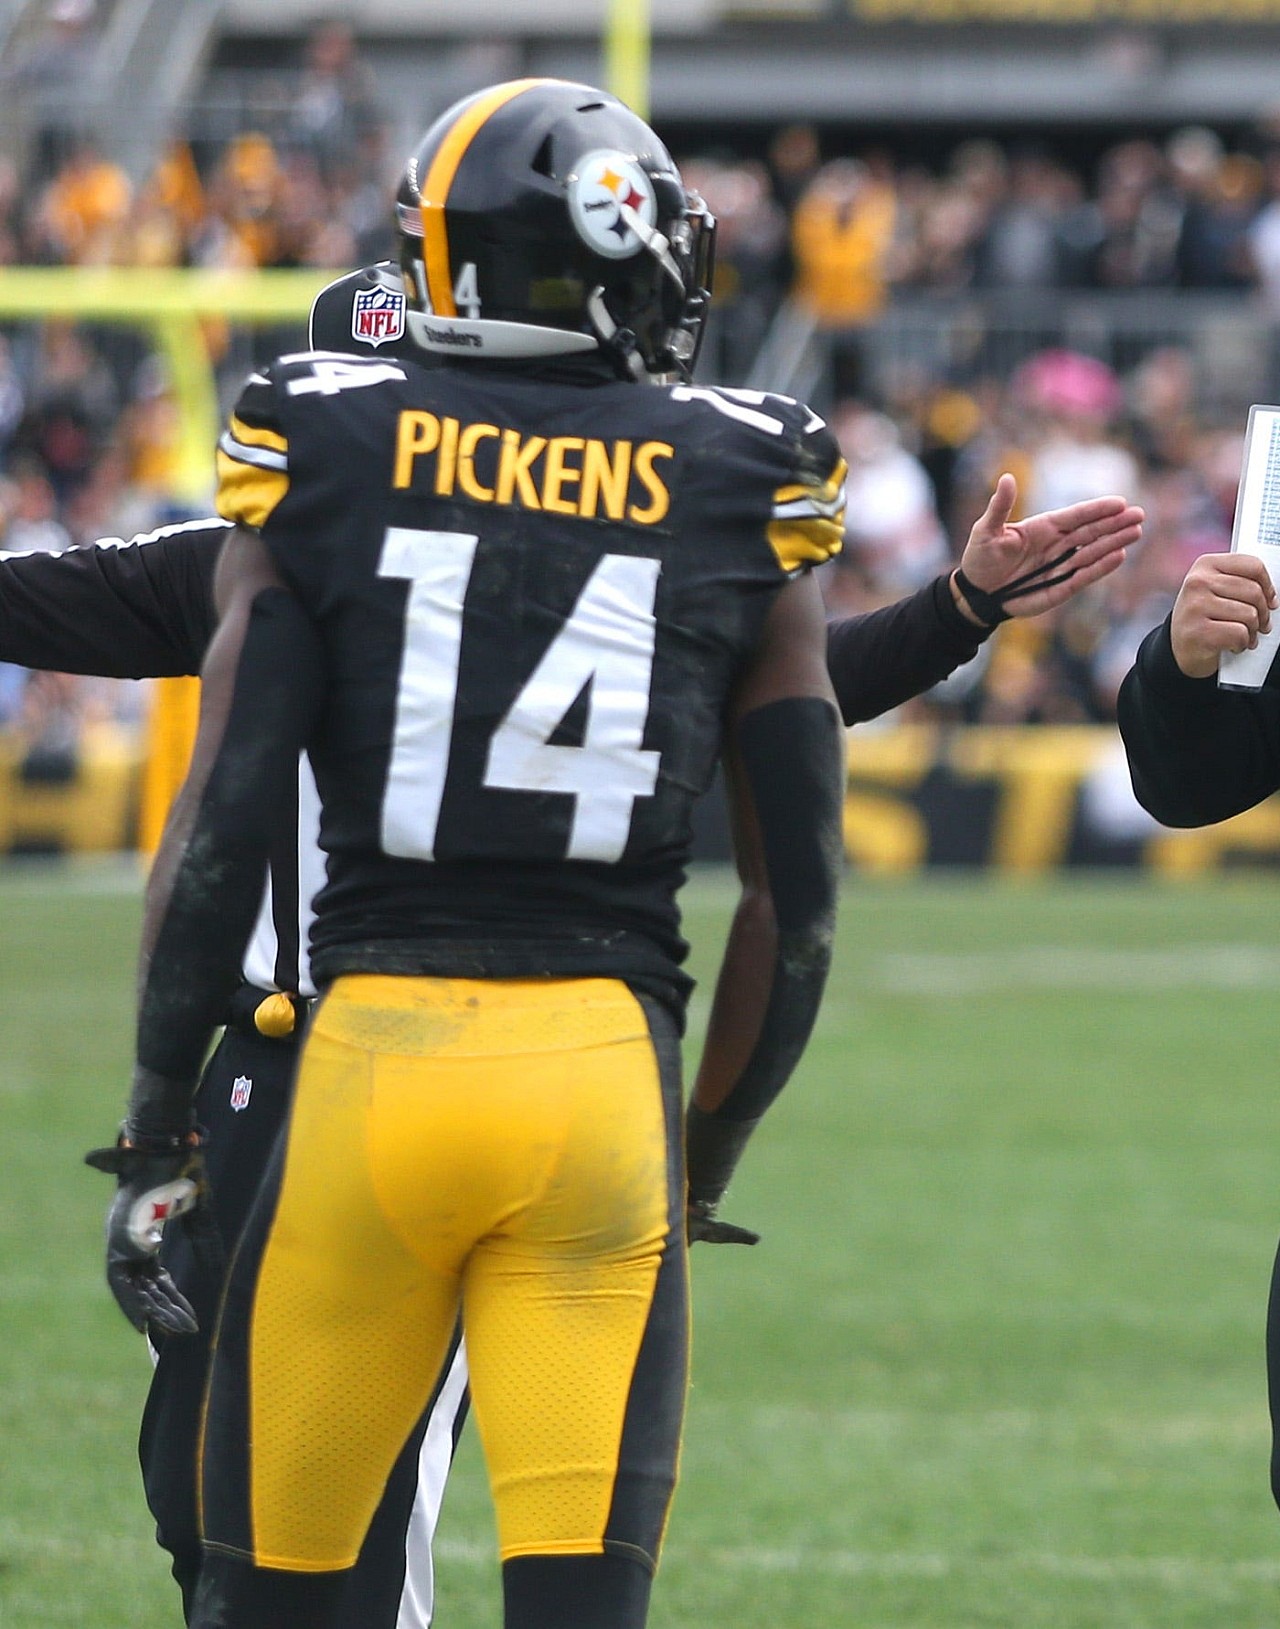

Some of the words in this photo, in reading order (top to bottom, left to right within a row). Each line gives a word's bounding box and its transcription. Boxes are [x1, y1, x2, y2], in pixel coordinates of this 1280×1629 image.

[359, 311, 397, 337] NFL
[393, 408, 674, 524] PICKENS
[376, 527, 662, 864] 14
